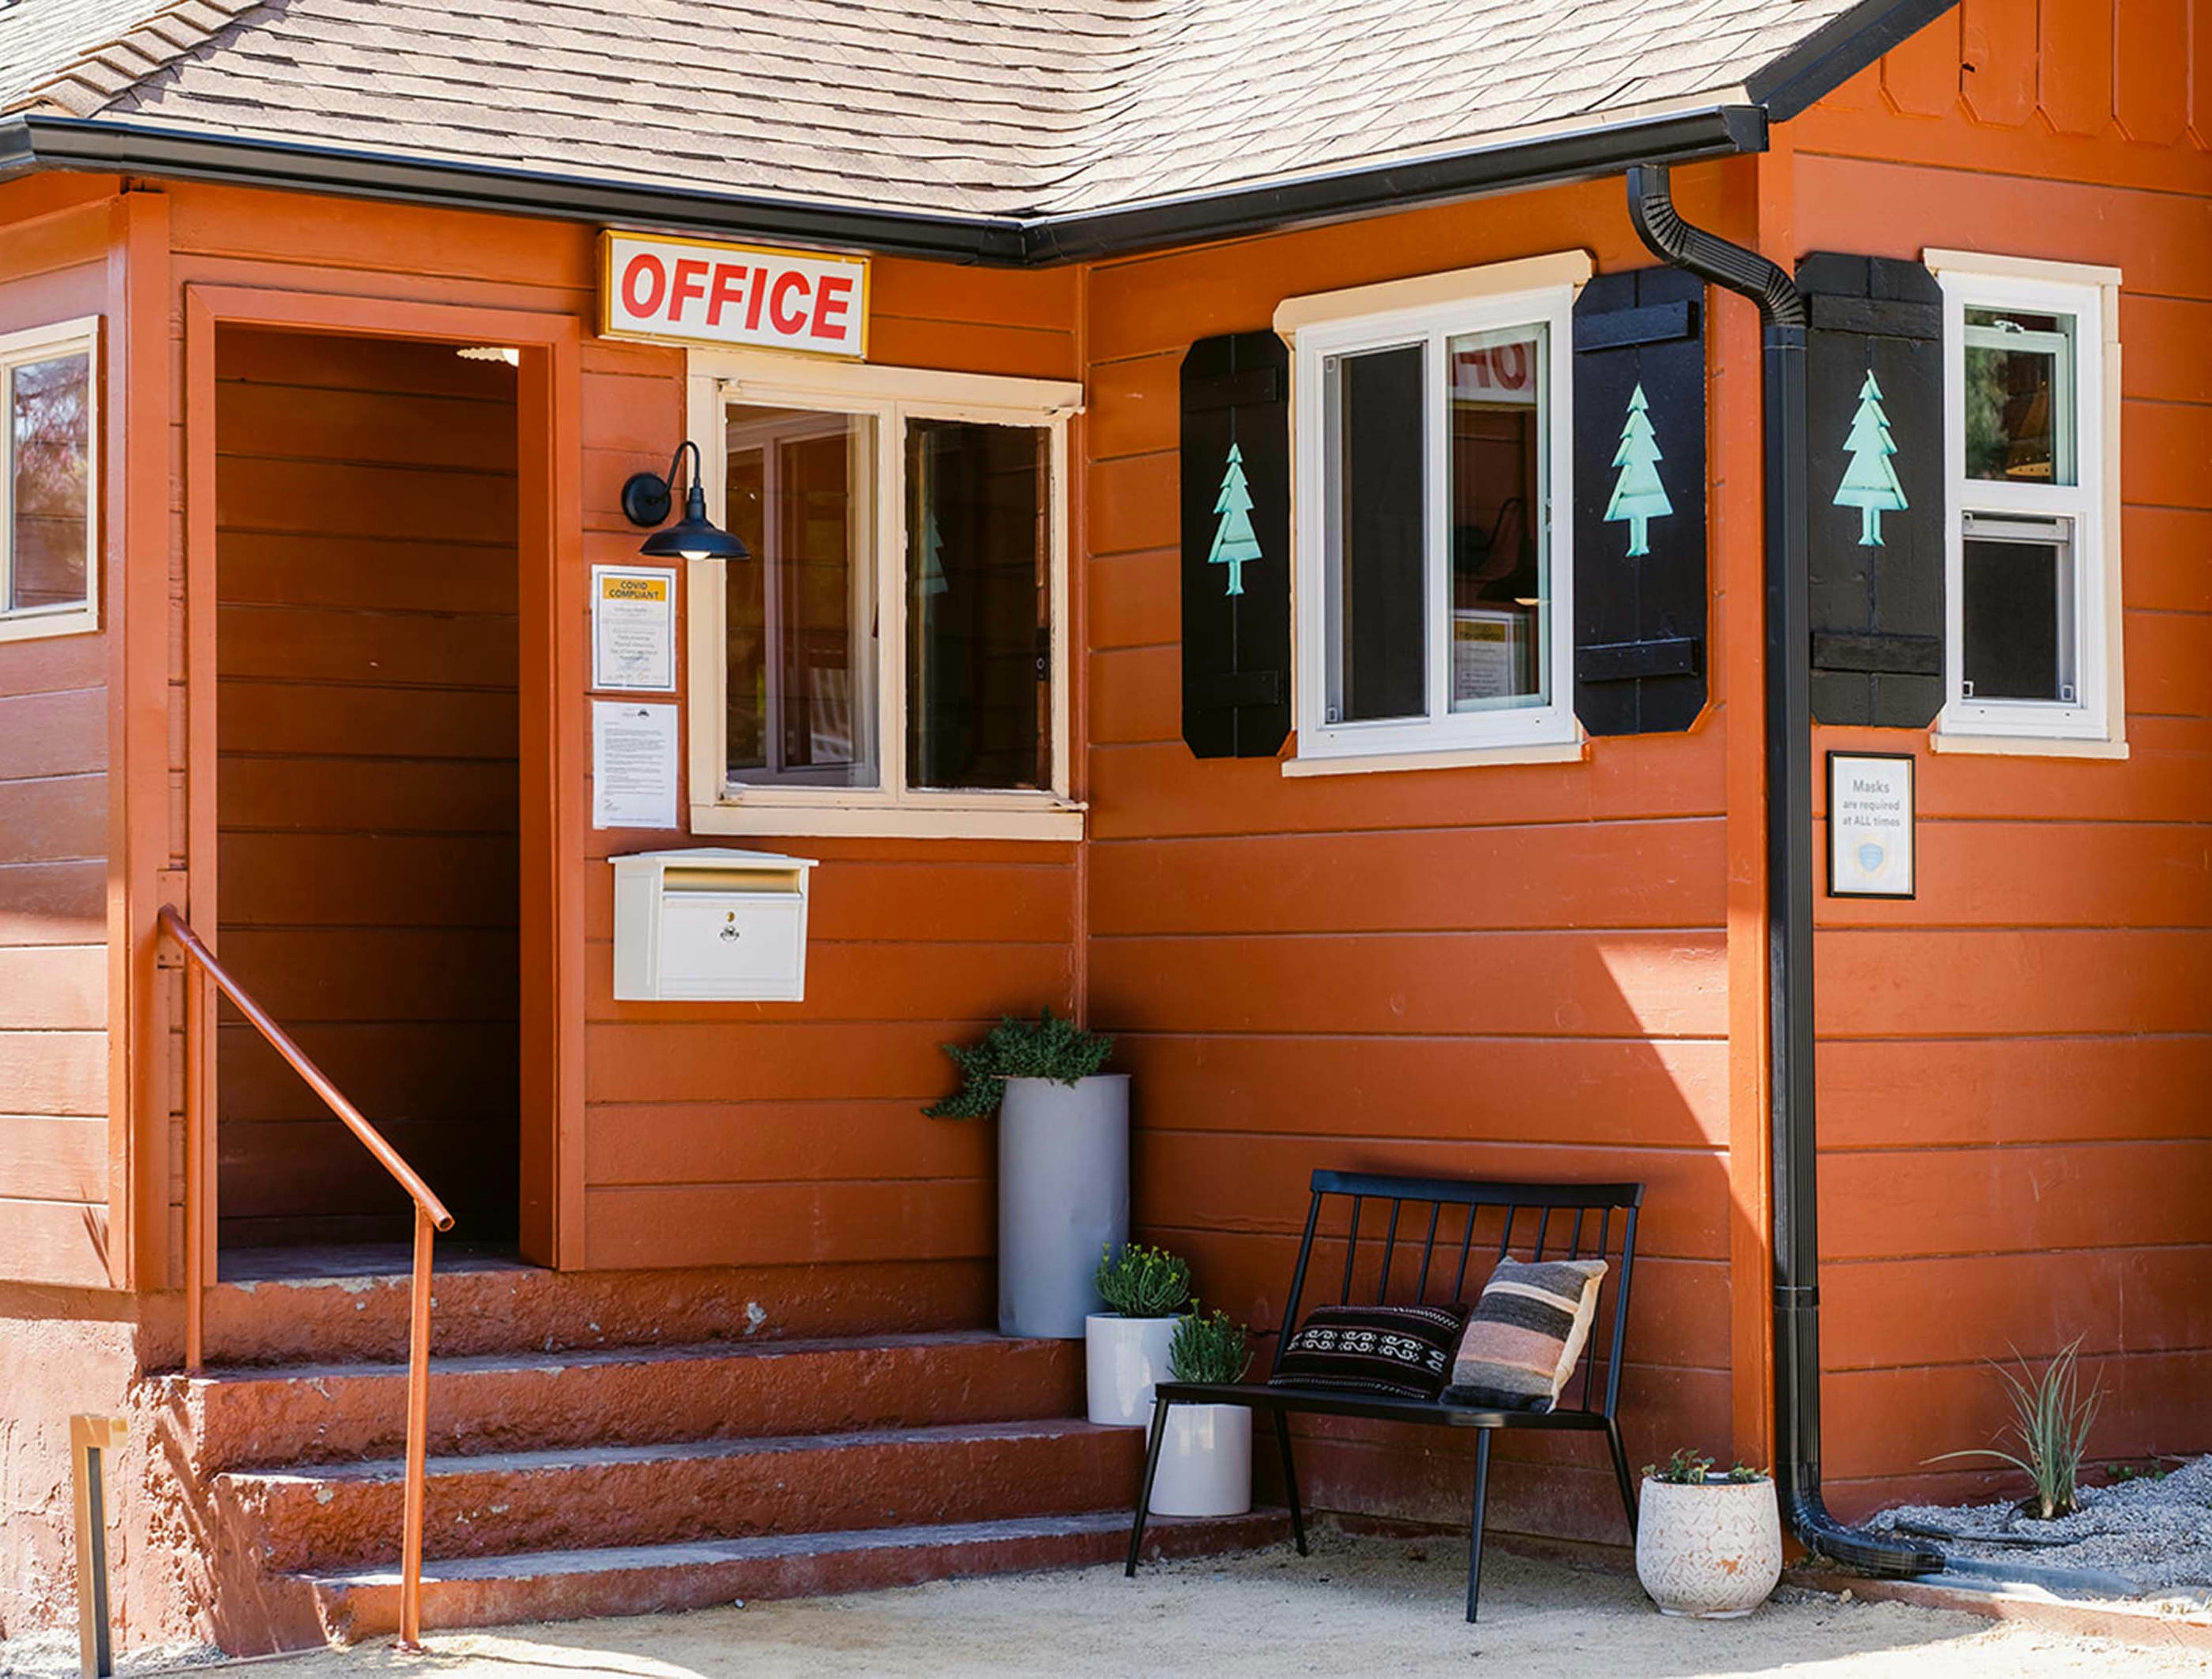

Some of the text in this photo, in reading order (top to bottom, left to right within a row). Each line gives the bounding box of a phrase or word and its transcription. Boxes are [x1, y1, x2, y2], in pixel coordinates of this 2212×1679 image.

[622, 253, 853, 340] OFFICE
[621, 581, 648, 590] COVID
[609, 589, 658, 599] COMPLIANT
[1852, 779, 1890, 793] Masks
[1859, 799, 1900, 811] required
[1843, 816, 1900, 827] at ALL times
